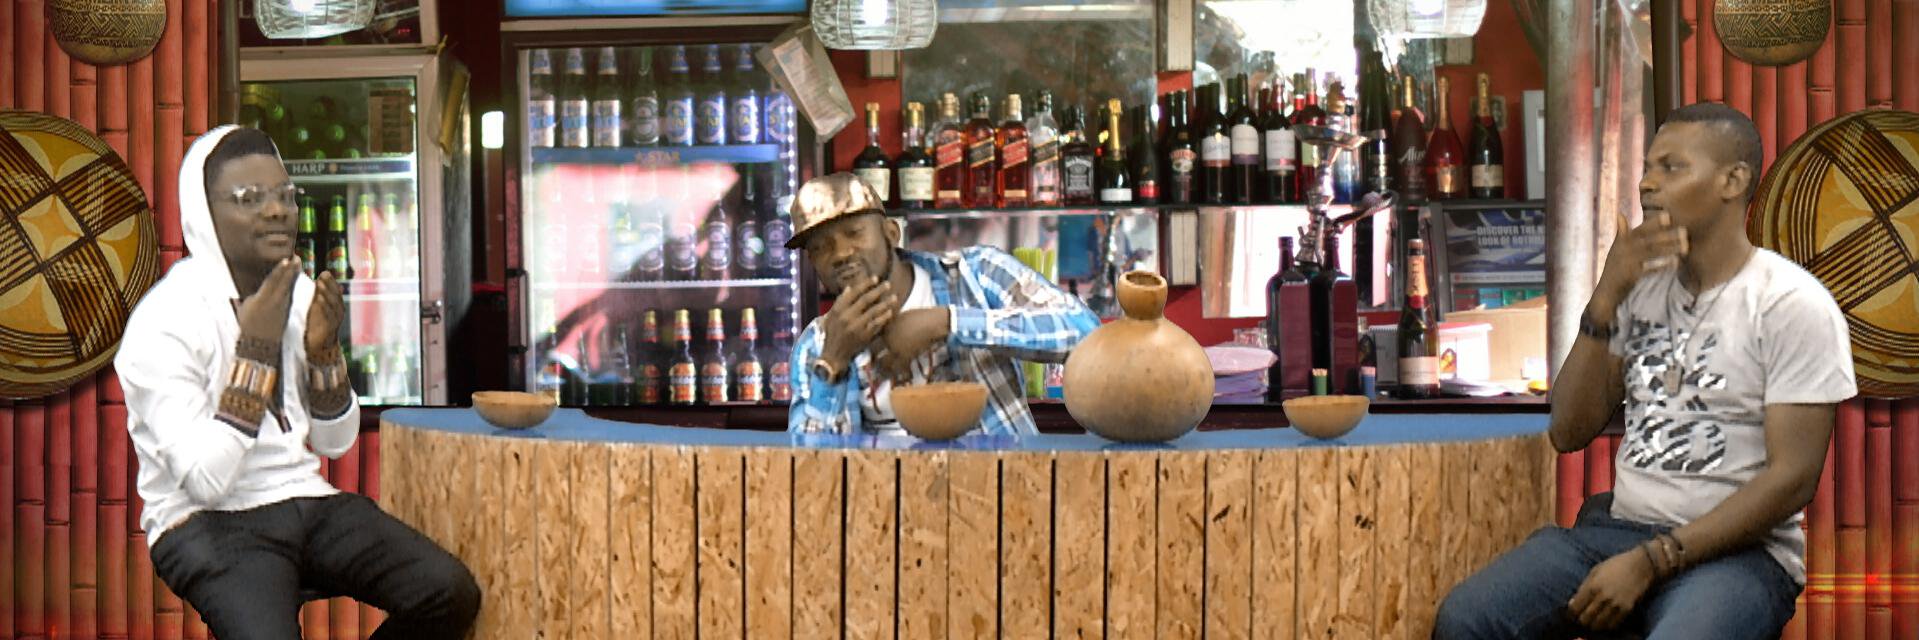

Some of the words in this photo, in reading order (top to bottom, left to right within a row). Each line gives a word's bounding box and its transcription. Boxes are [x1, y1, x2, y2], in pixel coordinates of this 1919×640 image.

[292, 163, 326, 174] HARP
[1476, 225, 1519, 235] DISCOVER
[1520, 225, 1537, 234] THE
[1537, 225, 1546, 234] N
[1478, 236, 1500, 246] LOOK
[1501, 236, 1511, 246] OF
